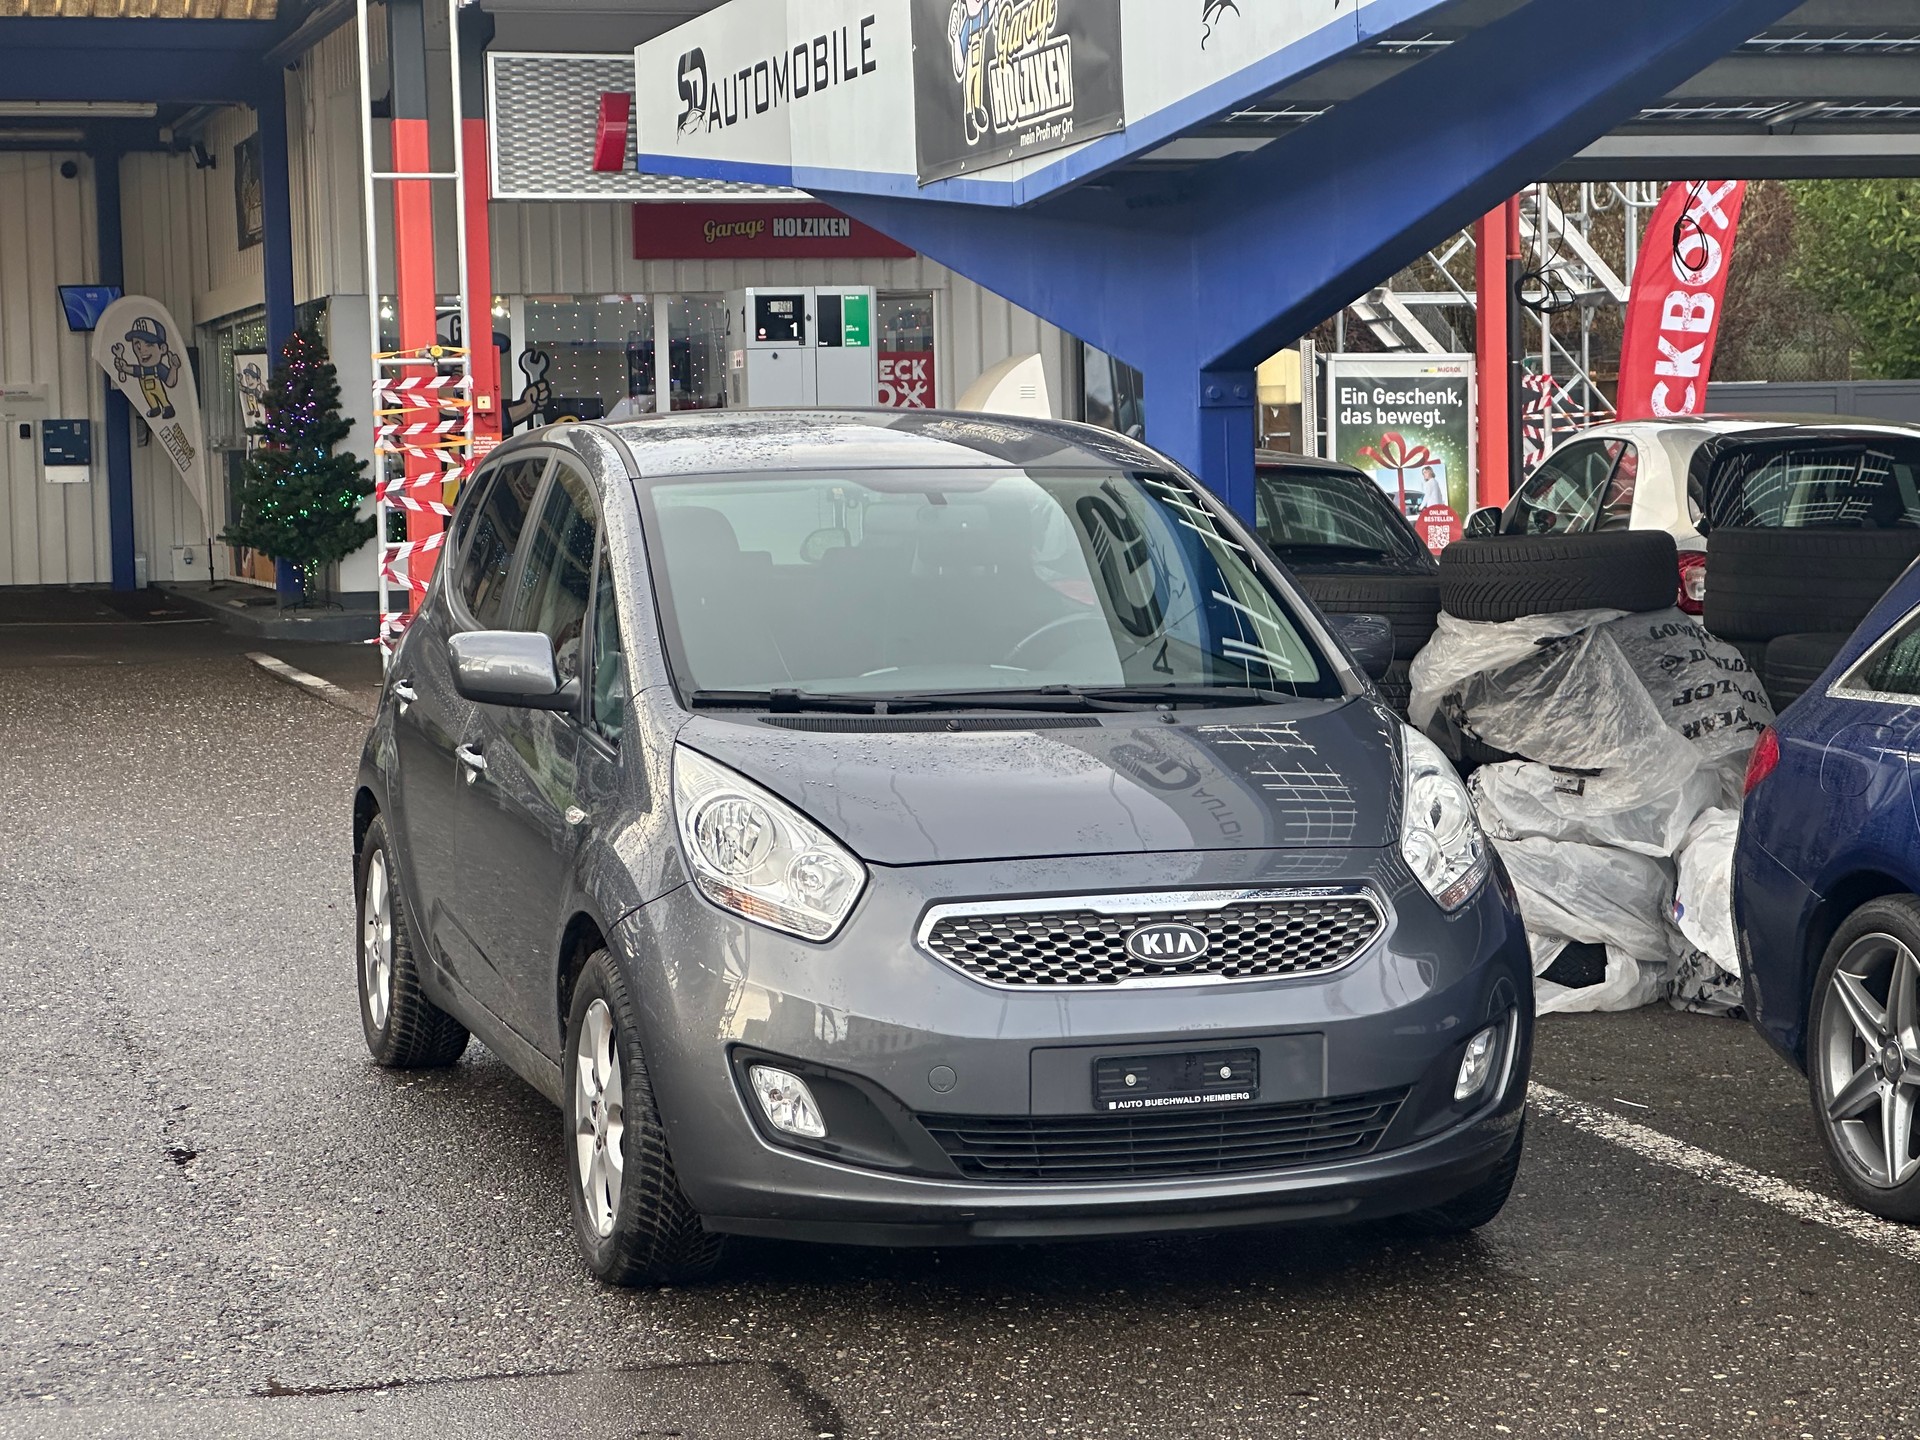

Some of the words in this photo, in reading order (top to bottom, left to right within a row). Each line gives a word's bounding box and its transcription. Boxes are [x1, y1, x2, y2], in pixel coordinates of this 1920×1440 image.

[997, 0, 1056, 72] Garage
[708, 13, 877, 134] AUTOMOBILE
[990, 44, 1071, 125] HOLZIKEN
[1020, 127, 1035, 146] mein
[1036, 122, 1051, 143] Profi
[1051, 123, 1062, 138] vor
[1062, 117, 1073, 135] Ort
[703, 219, 765, 243] Garage
[772, 217, 850, 237] HOLZIKEN
[726, 308, 731, 336] 2
[789, 321, 798, 338] 1
[1340, 387, 1368, 405] Ein
[1373, 387, 1463, 408] Geschenk,
[1340, 407, 1372, 425] das
[1376, 407, 1446, 429] bewegt.
[1140, 932, 1198, 955] KIA
[1117, 1099, 1143, 1109] AUTO
[1144, 1095, 1201, 1107] BUECHWALD
[1202, 1092, 1250, 1103] HEIMBERG
